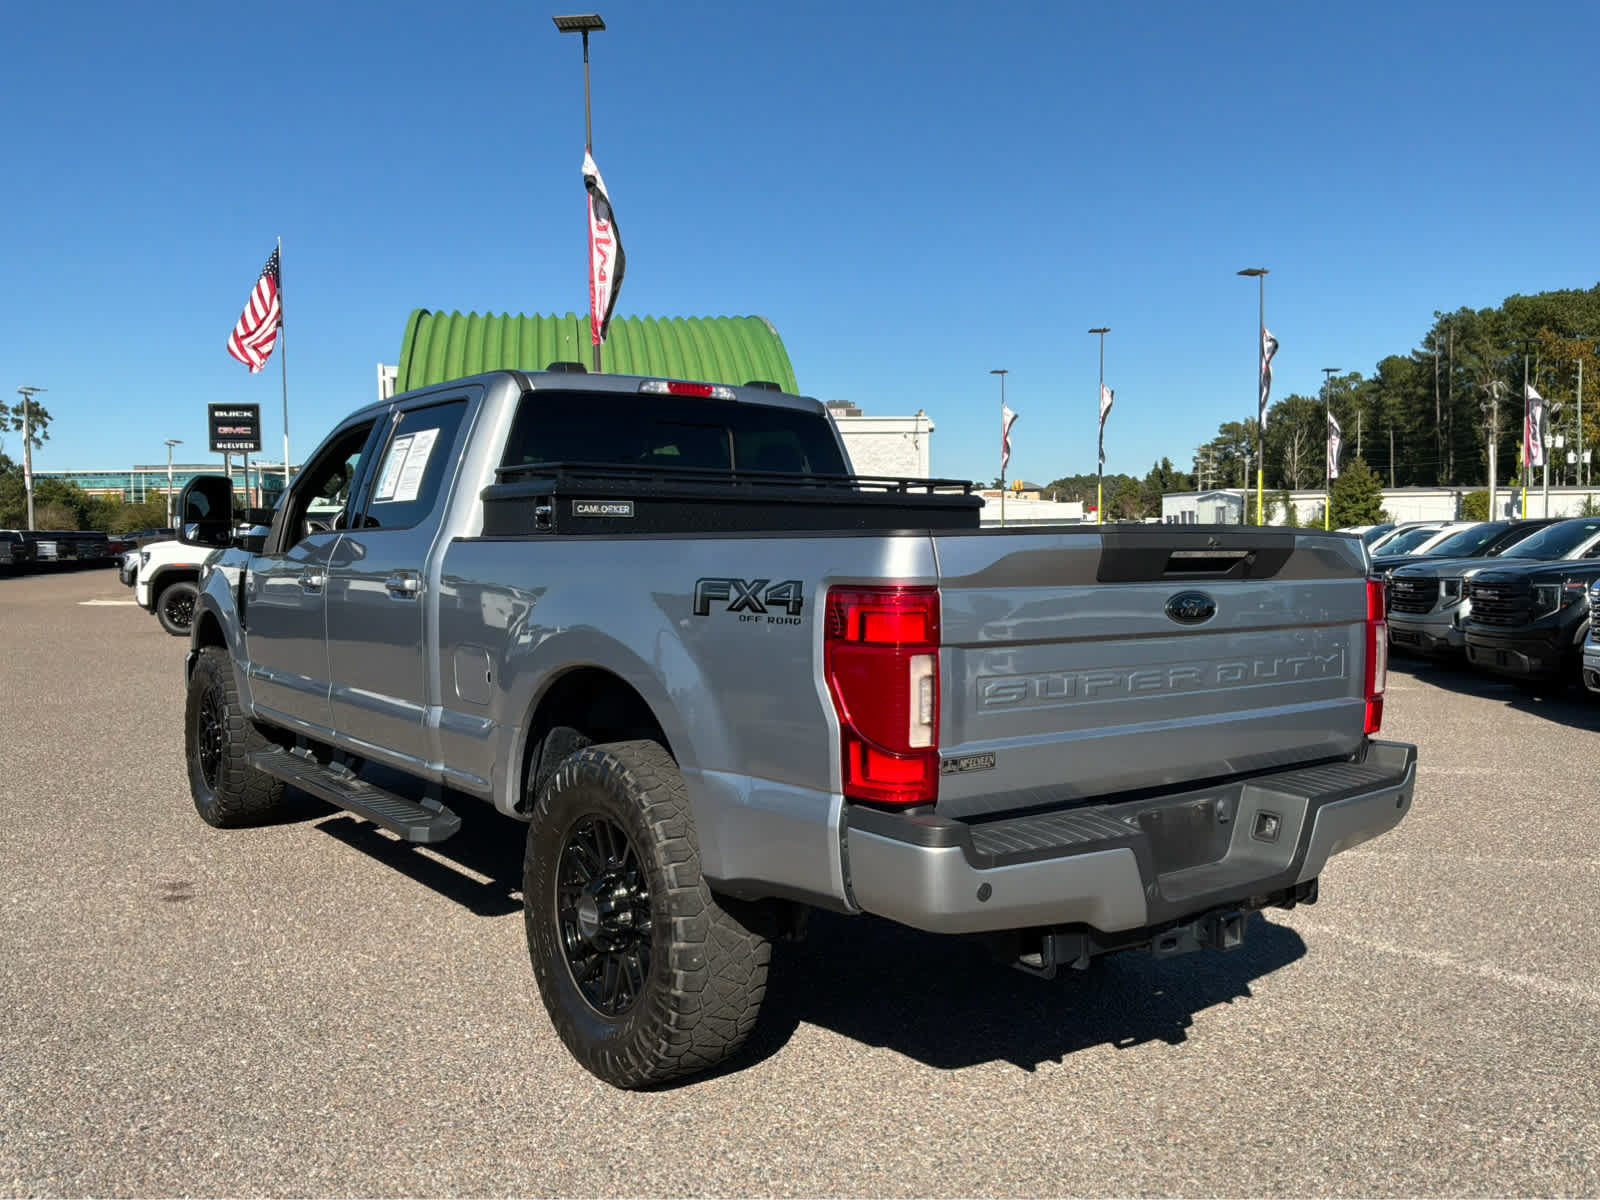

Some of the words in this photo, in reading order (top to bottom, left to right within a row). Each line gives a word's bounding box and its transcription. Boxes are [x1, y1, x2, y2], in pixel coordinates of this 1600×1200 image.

[693, 578, 803, 616] FX4
[767, 616, 801, 625] ROAD
[984, 665, 1204, 704] SUPER
[1217, 653, 1339, 682] DUTY
